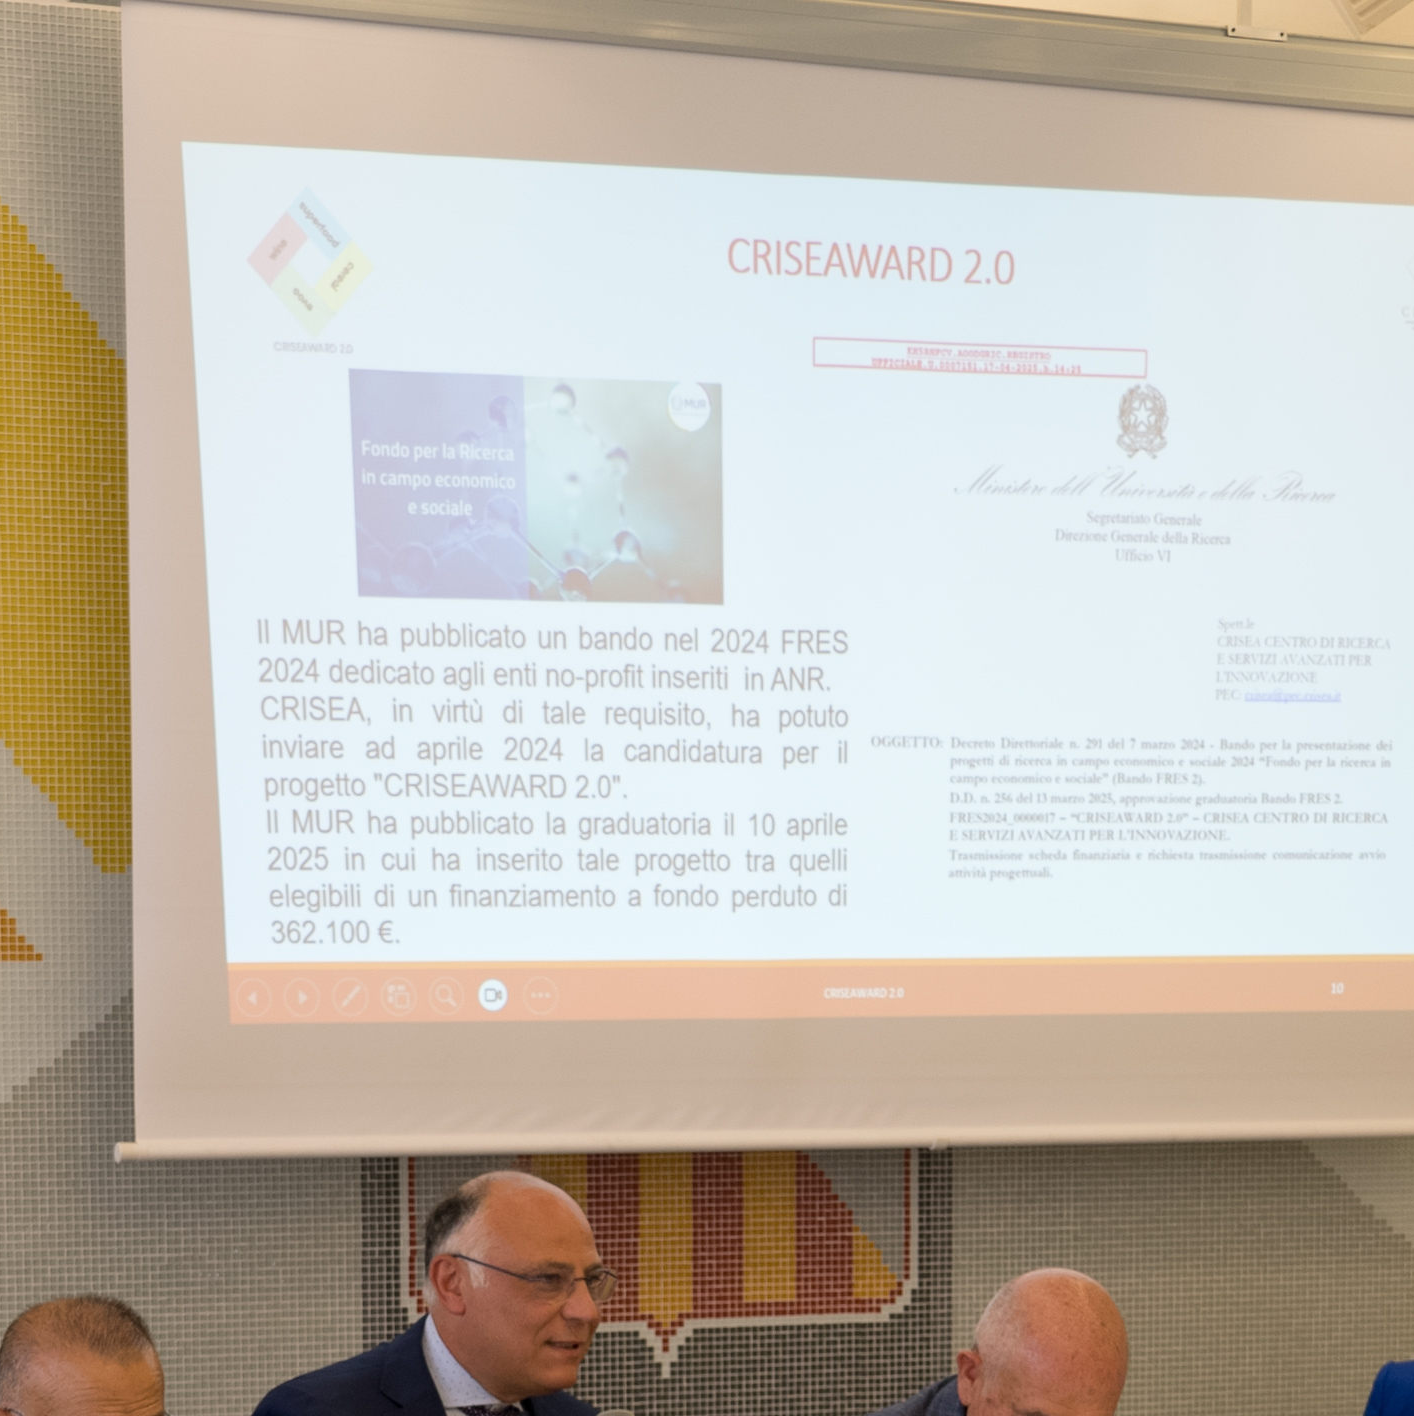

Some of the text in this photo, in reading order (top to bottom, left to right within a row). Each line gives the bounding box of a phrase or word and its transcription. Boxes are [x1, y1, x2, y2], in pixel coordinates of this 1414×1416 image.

[299, 201, 340, 248] superfood
[269, 239, 288, 261] wine
[728, 238, 1014, 285] CRISEAWARD 2.0
[330, 262, 354, 292] cereal
[273, 341, 353, 354] CRISEAWARD 2.0
[685, 398, 707, 410] MUR
[362, 440, 514, 462] Fondo per la Ricerca
[362, 468, 515, 490] in campo economico
[408, 500, 472, 516] e sociale
[1087, 511, 1202, 527] Segretariato Generale
[1056, 529, 1231, 545] Direzione Generale della Ricerca
[1116, 548, 1171, 563] Ufficio VI
[258, 619, 848, 654] Il MUR ha pubblicato un bando nel 2024 FRES
[1217, 636, 1390, 649] CRISEA CENTRO DI RICERCA
[1217, 653, 1372, 666] E SERVIZI AVANZATI PER
[259, 657, 830, 693] 2024 dedicato agli enti no-profit inseriti in ANR.
[261, 696, 849, 733] CRISEA, in virtù di tale requisito, ha potuto
[262, 734, 847, 770] inviare ad aprile 2024 la candidatura per il
[265, 773, 366, 802] progetto
[267, 809, 848, 841] Il MUR ha pubblicato la graduatoria il 10 aprile
[268, 846, 847, 877] 2025 in cui ha inserito tale progetto tra quelli
[949, 849, 1023, 861] Trasmissione
[1029, 850, 1067, 860] scheda
[1073, 849, 1130, 860] finanziaria
[1148, 849, 1194, 860] richiesta
[1200, 850, 1267, 860] trasmissione
[1272, 850, 1353, 860] comunicazione
[1359, 850, 1386, 860] avvio
[269, 883, 847, 913] elegibili di un finanziamento a fondo perduto di
[271, 920, 370, 944] 362.100
[824, 987, 904, 998] CRISEAWARD 2.0
[1331, 983, 1344, 994] 10
